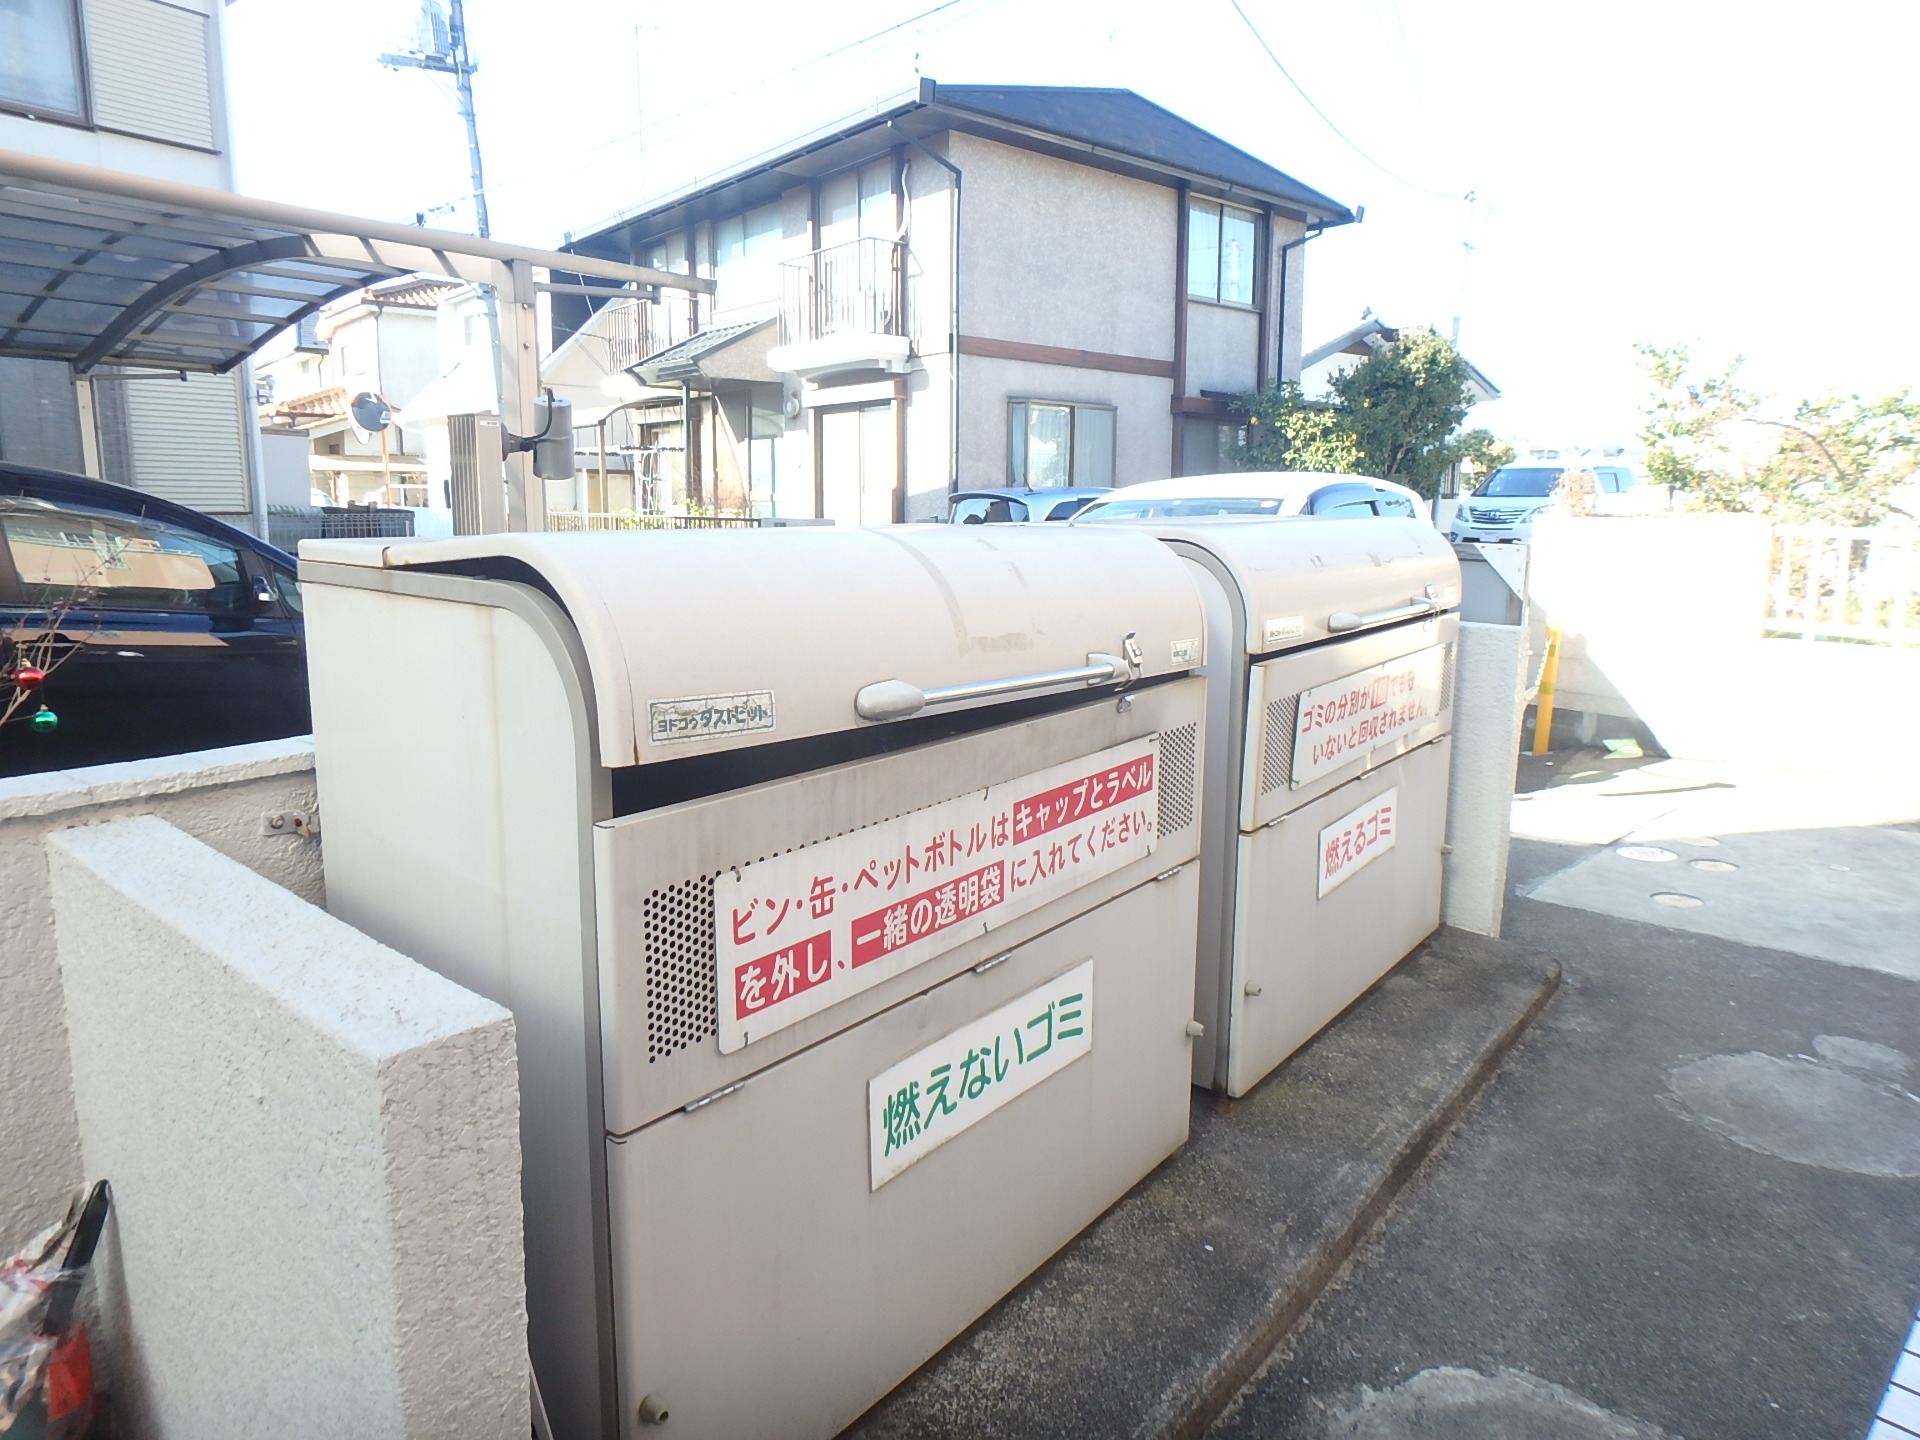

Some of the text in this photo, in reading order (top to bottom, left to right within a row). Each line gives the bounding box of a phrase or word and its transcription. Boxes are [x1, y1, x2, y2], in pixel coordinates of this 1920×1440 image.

[1325, 806, 1391, 879] 燃えるゴミ
[883, 993, 1083, 1157] 燃えないゴミ
